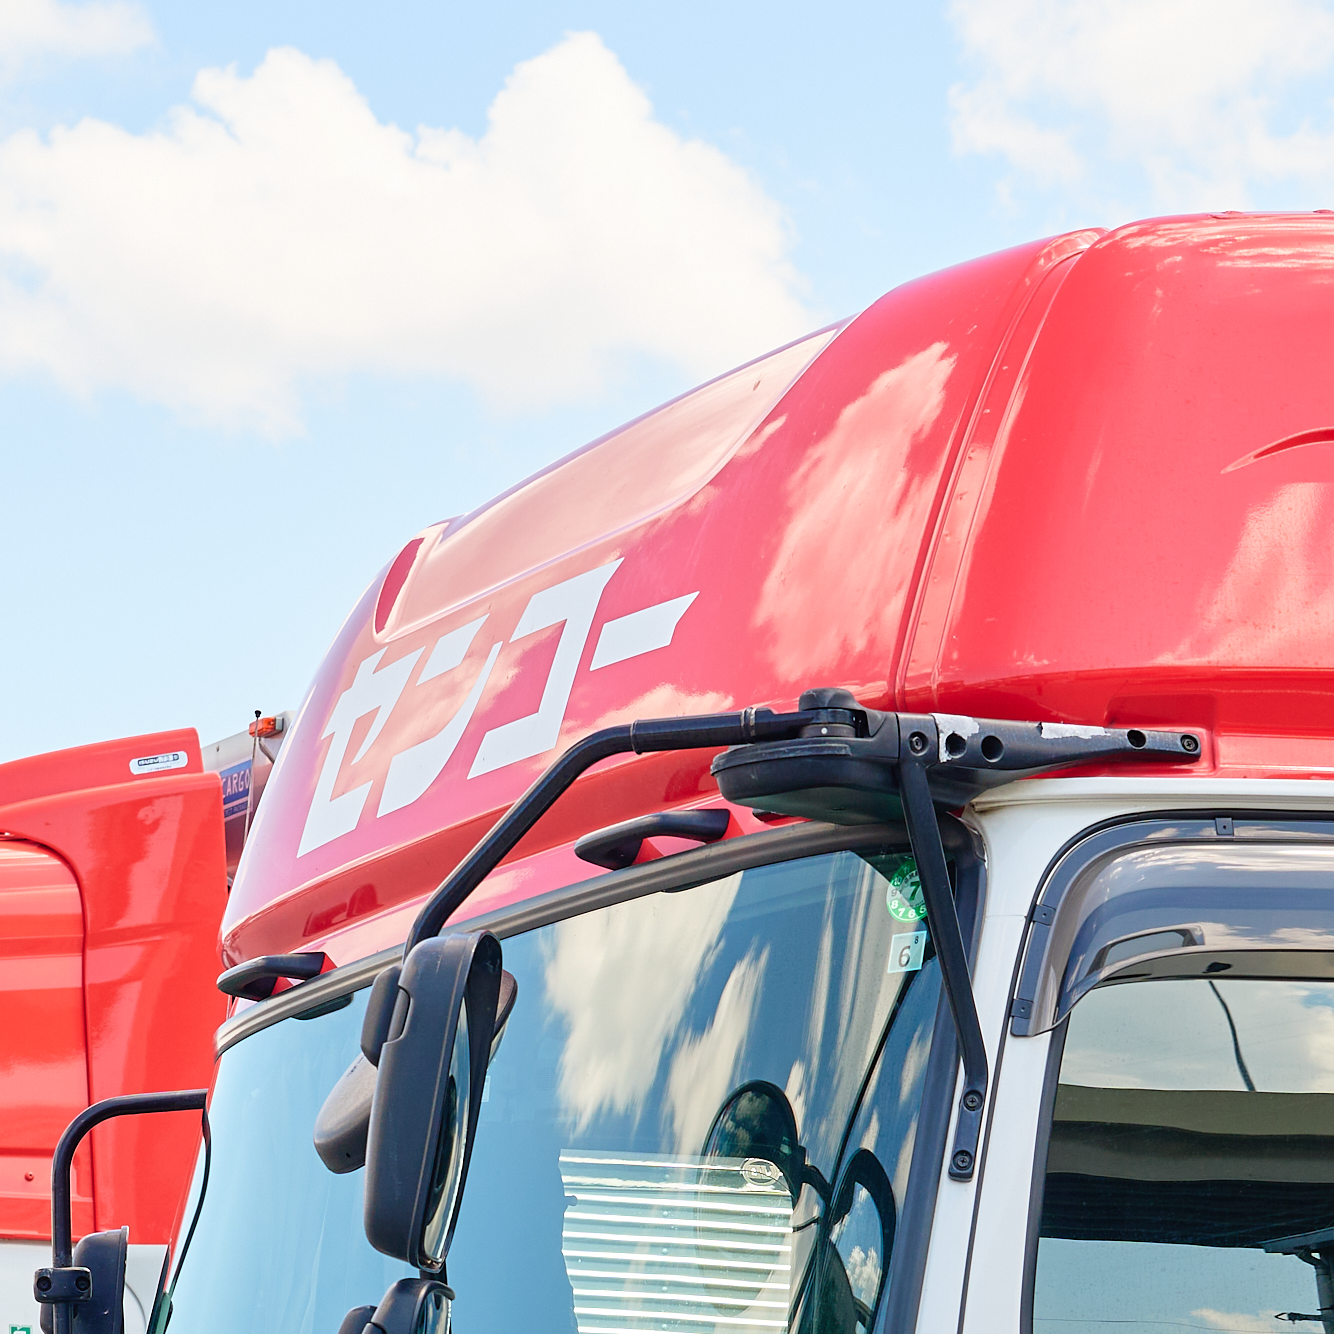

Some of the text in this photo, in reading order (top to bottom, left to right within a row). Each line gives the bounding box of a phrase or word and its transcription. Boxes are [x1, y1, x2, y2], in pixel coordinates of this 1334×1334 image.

[298, 557, 700, 858] センコー
[910, 881, 921, 901] 7
[891, 899, 899, 910] 8
[908, 909, 916, 919] 6
[898, 945, 911, 968] 6
